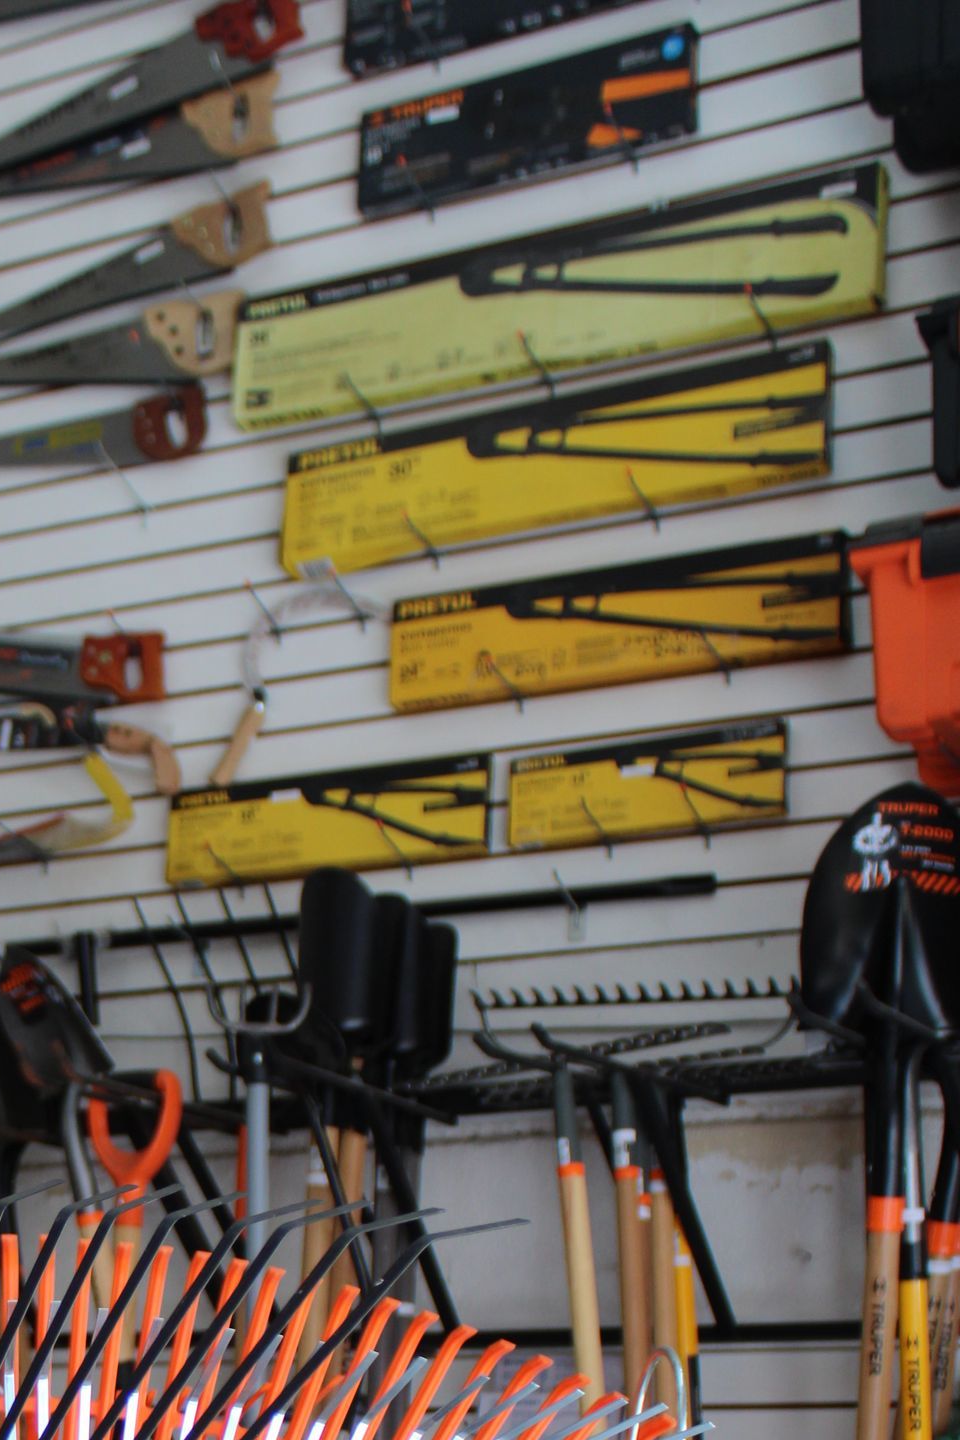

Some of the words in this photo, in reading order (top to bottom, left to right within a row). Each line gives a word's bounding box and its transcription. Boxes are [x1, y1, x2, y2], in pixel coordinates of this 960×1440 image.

[399, 591, 477, 619] PRETUL
[878, 800, 940, 817] TRUPER
[869, 1302, 886, 1377] TRUPER
[906, 1357, 922, 1433] TRUPER
